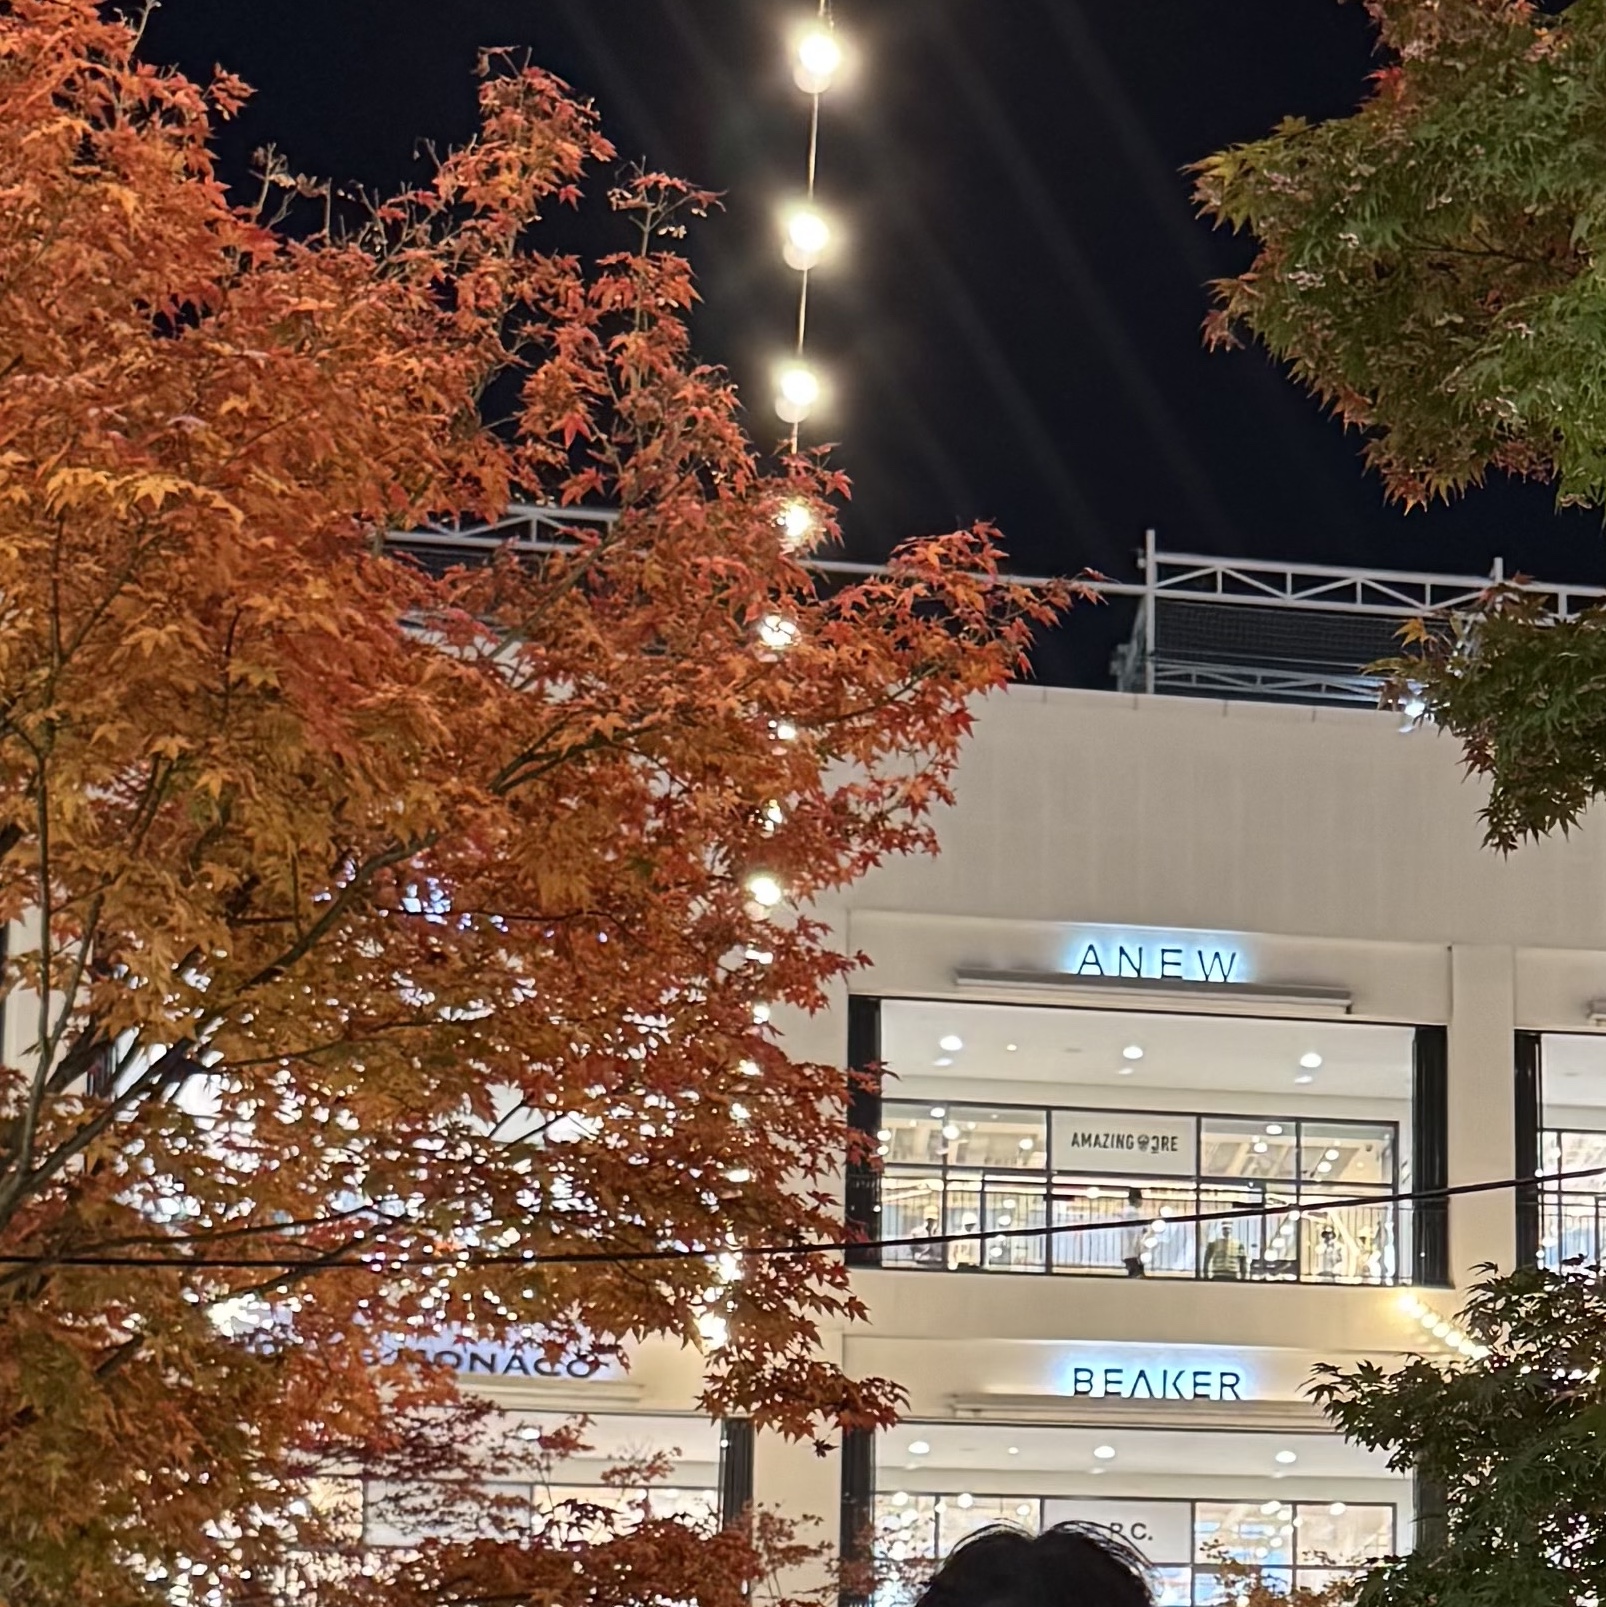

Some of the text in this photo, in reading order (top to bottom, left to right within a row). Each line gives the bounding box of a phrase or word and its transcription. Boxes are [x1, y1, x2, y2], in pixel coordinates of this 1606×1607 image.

[1077, 943, 1237, 983] ANEW
[1071, 1131, 1135, 1150] AMAZING
[397, 1348, 602, 1379] ONACO
[1073, 1367, 1242, 1401] BEAKER
